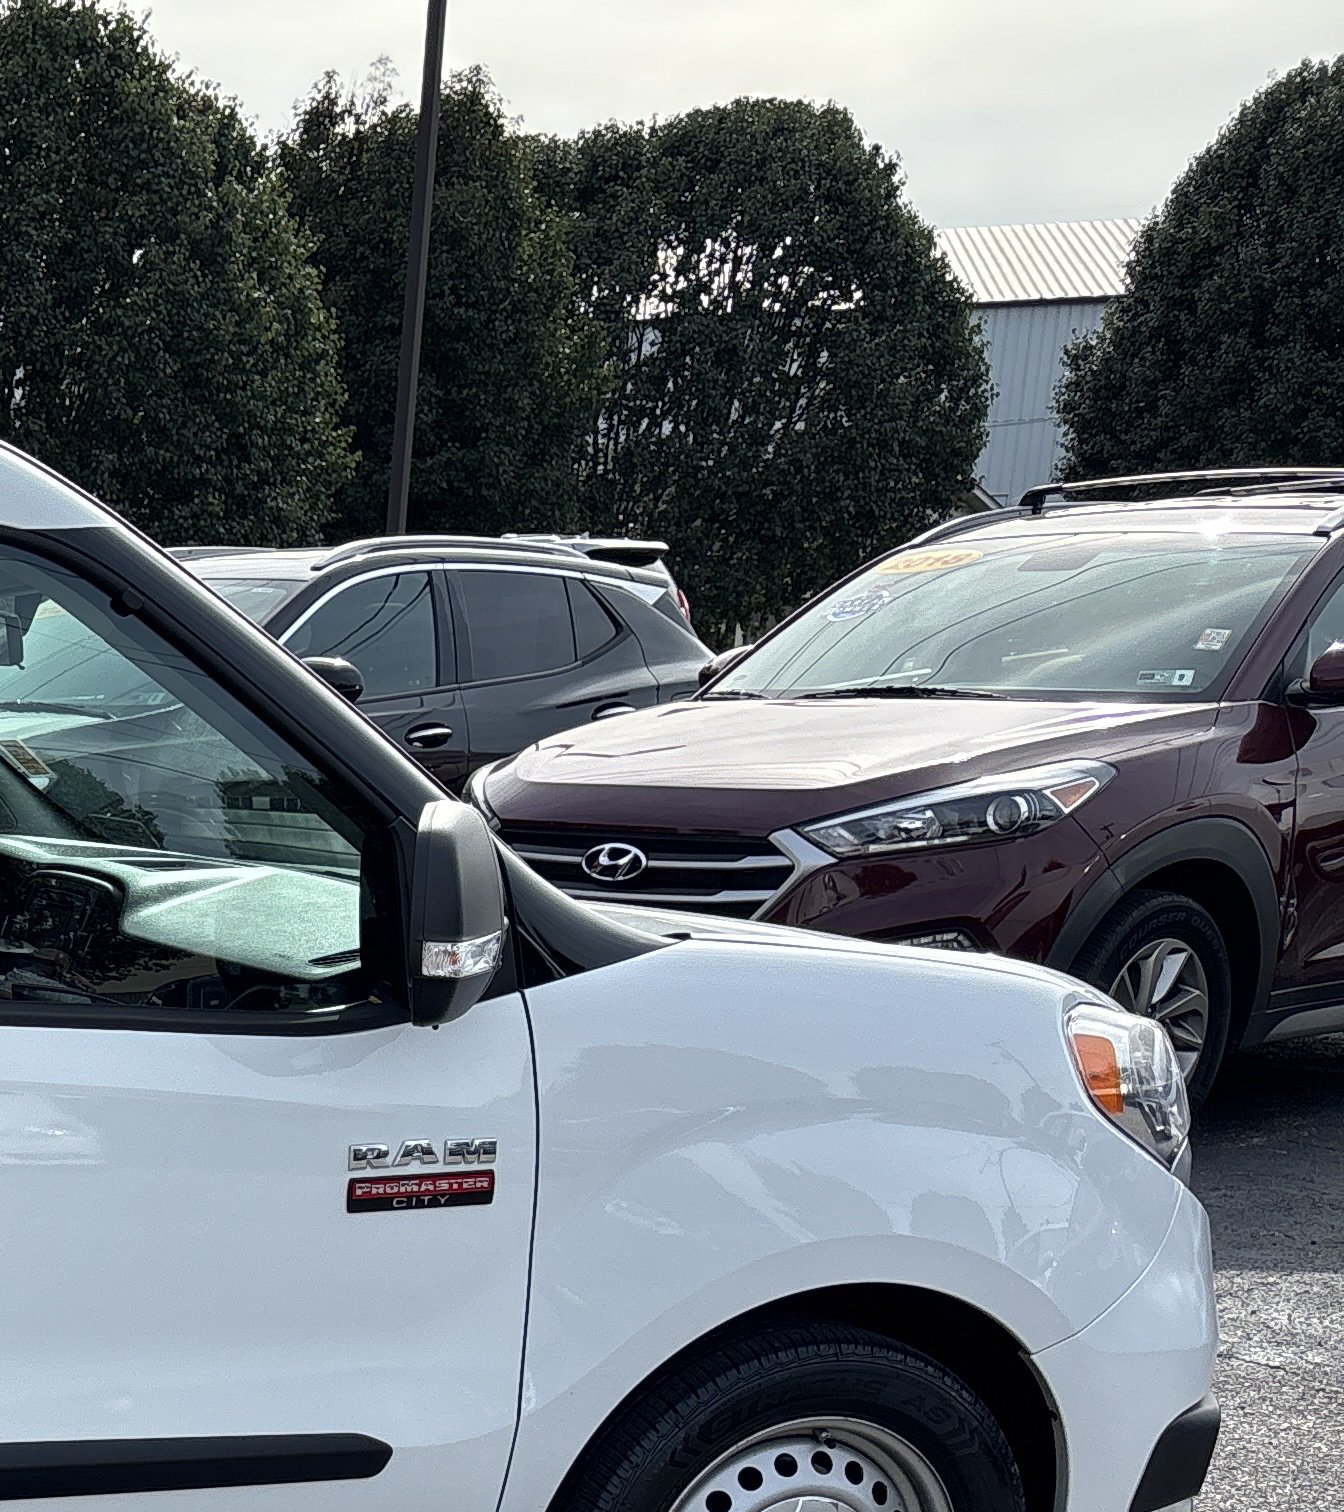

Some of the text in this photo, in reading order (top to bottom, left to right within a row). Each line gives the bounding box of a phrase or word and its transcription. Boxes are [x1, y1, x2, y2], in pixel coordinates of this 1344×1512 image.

[347, 1138, 497, 1171] RAM
[354, 1176, 490, 1196] PROMASTER
[392, 1194, 450, 1209] CITY
